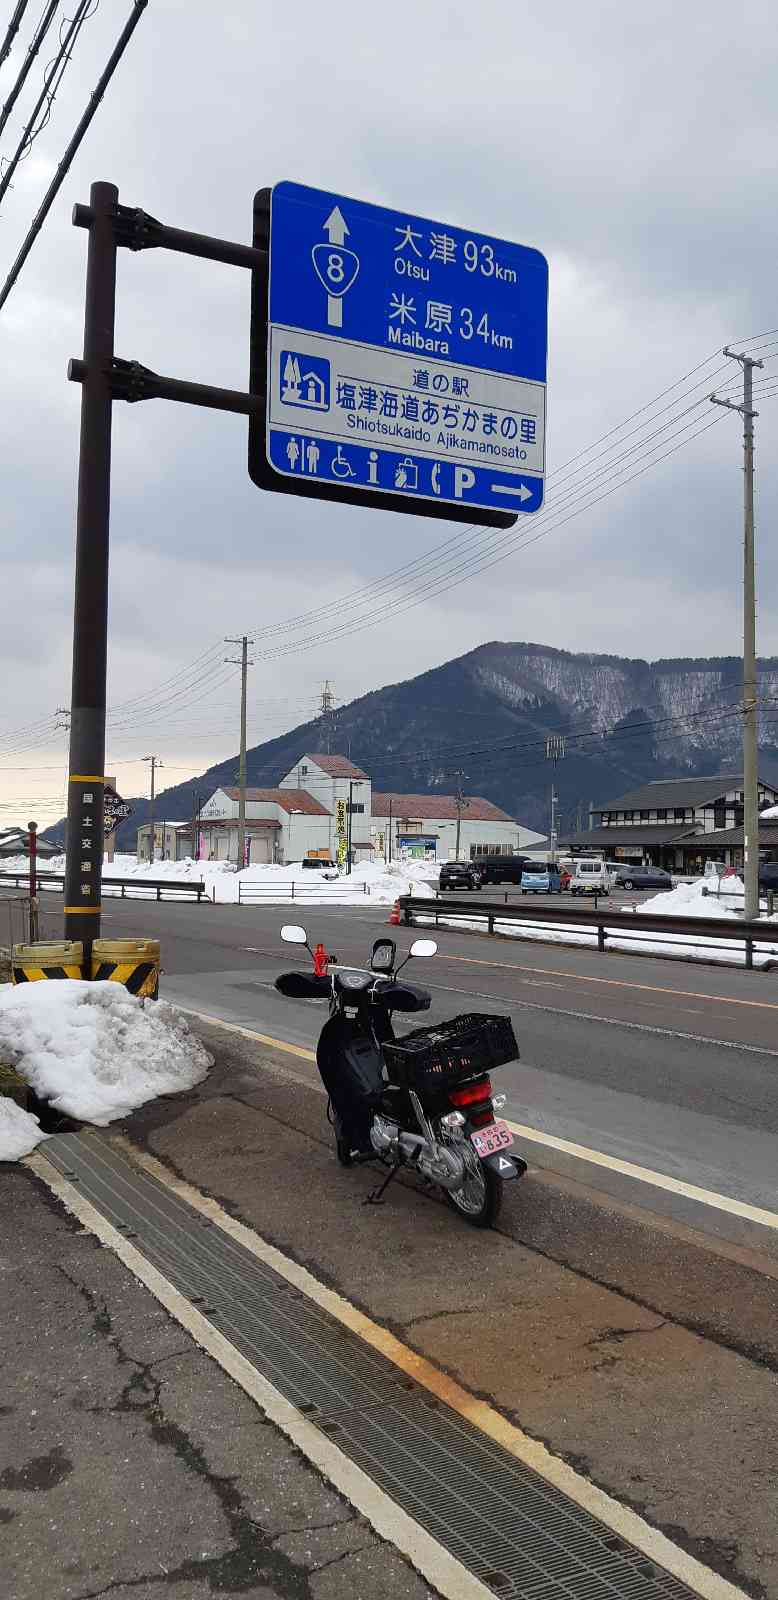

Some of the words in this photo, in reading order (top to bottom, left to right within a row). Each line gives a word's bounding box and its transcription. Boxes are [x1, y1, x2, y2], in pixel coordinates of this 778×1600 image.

[327, 254, 344, 283] 8
[394, 224, 458, 265] 大津
[463, 240, 518, 283] 93km
[394, 257, 430, 281] Otsu
[388, 292, 453, 335] 米原
[459, 307, 513, 350] 34km
[388, 325, 449, 354] Maibara
[412, 368, 470, 398] 道の駅
[335, 381, 537, 445] 塩津海道あぢかまの里
[346, 413, 431, 443] Shiotsukaido
[437, 431, 527, 460] Ajikamanosato
[454, 466, 476, 498] P
